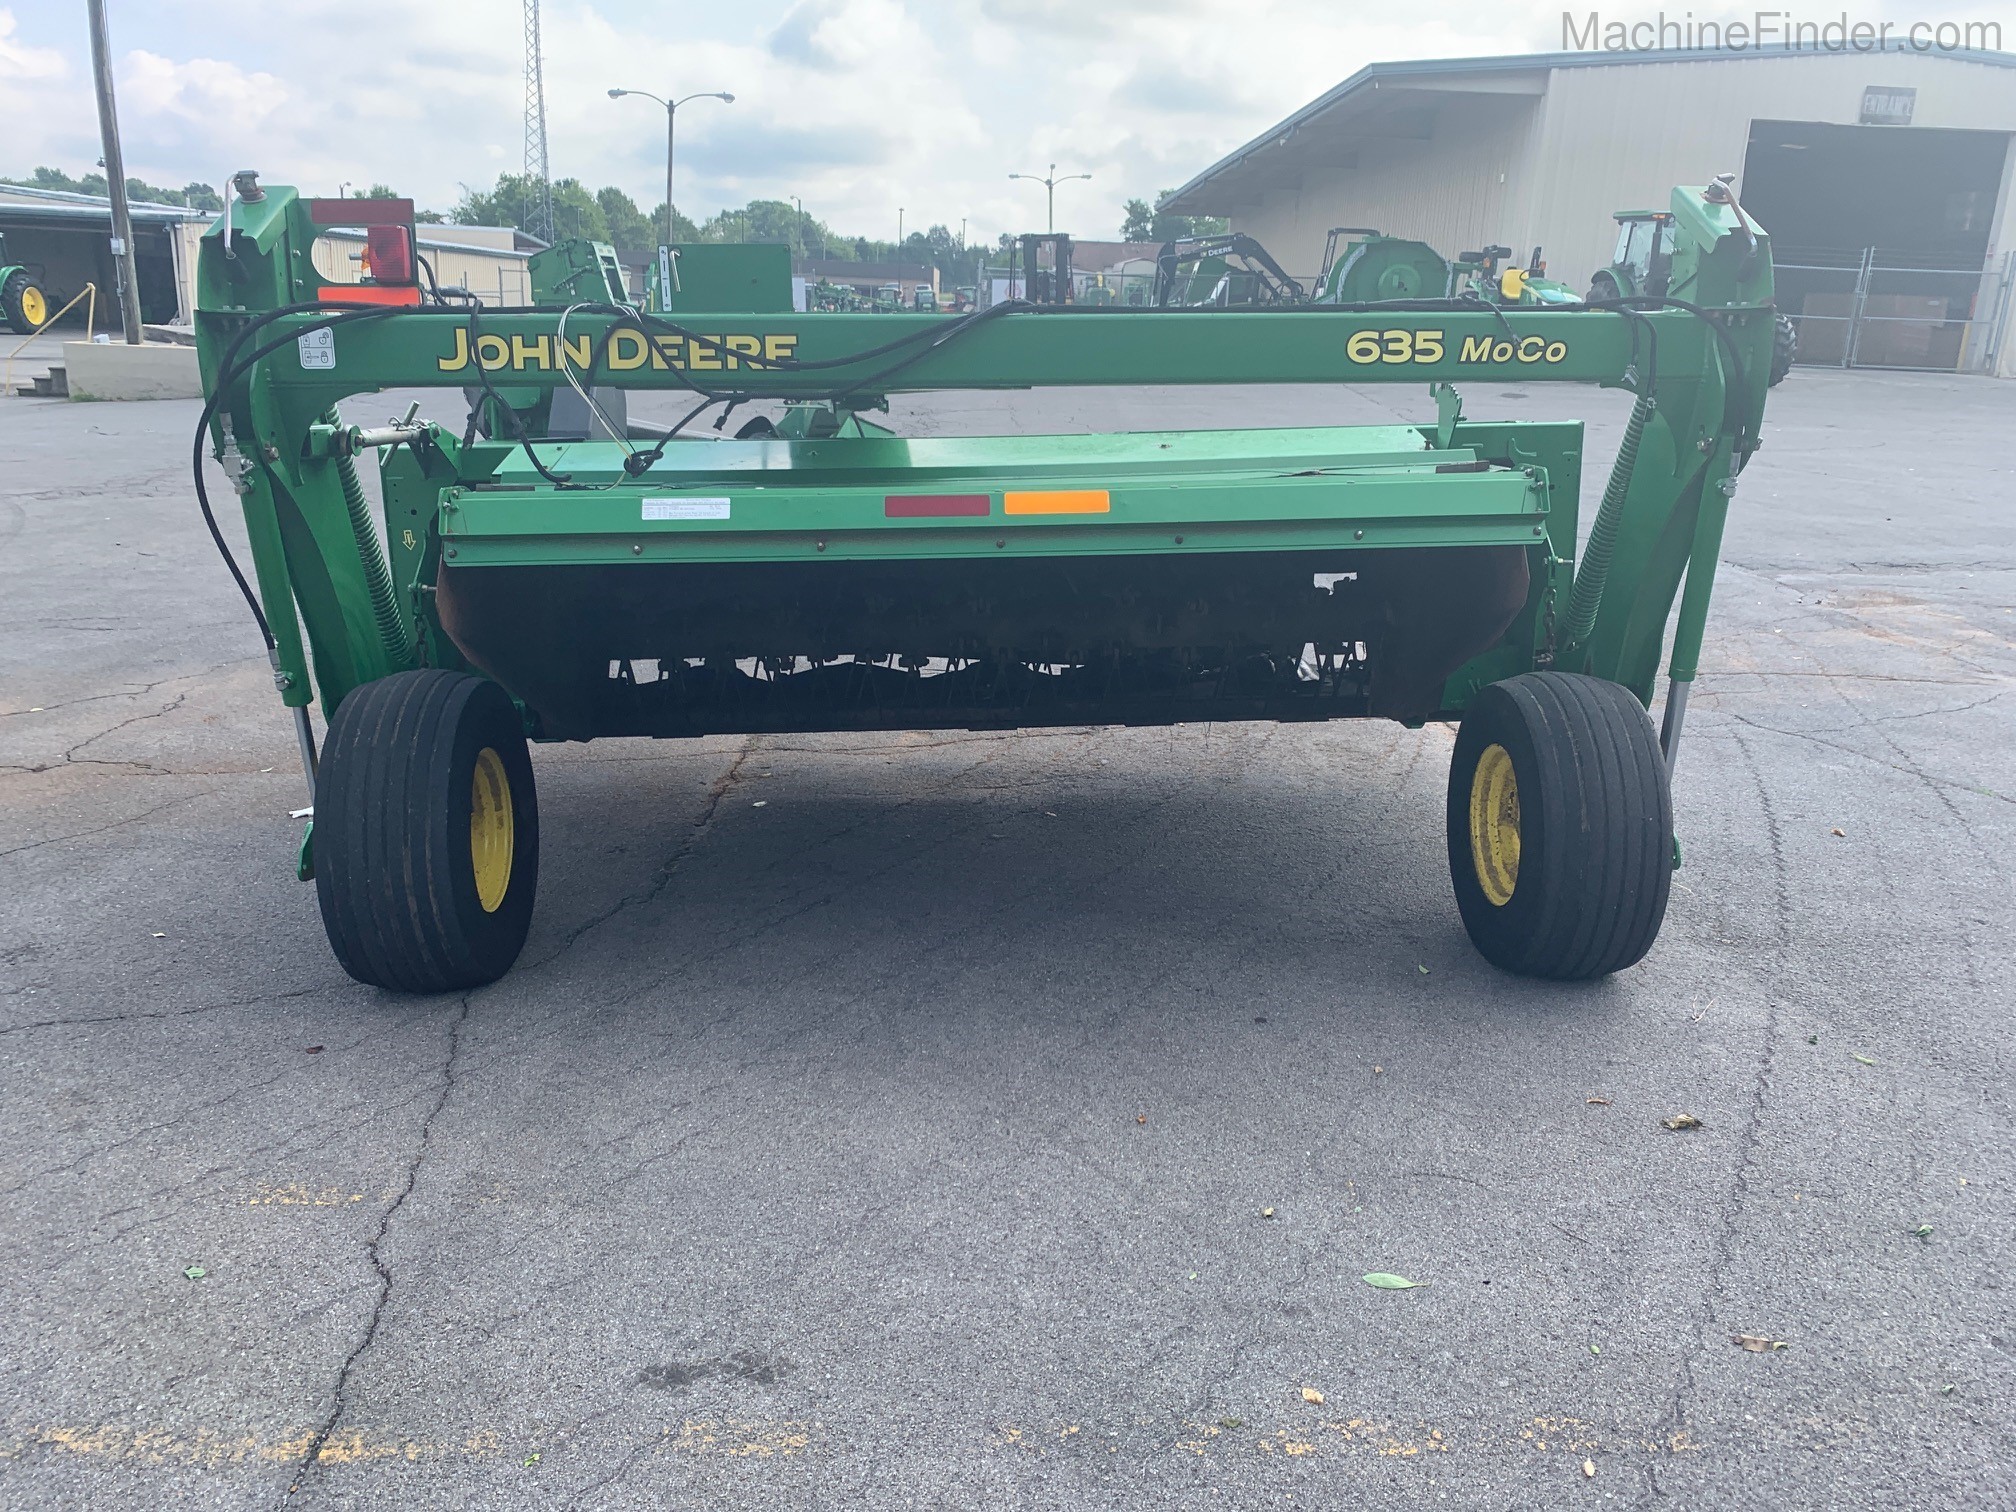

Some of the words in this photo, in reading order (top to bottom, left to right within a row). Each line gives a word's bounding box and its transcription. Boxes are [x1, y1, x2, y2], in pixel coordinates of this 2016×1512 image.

[1208, 246, 1233, 256] DEERE
[438, 328, 592, 371] JOHN
[607, 327, 798, 371] DEERE
[1347, 330, 1443, 364] 635
[1460, 336, 1567, 362] MoCo
